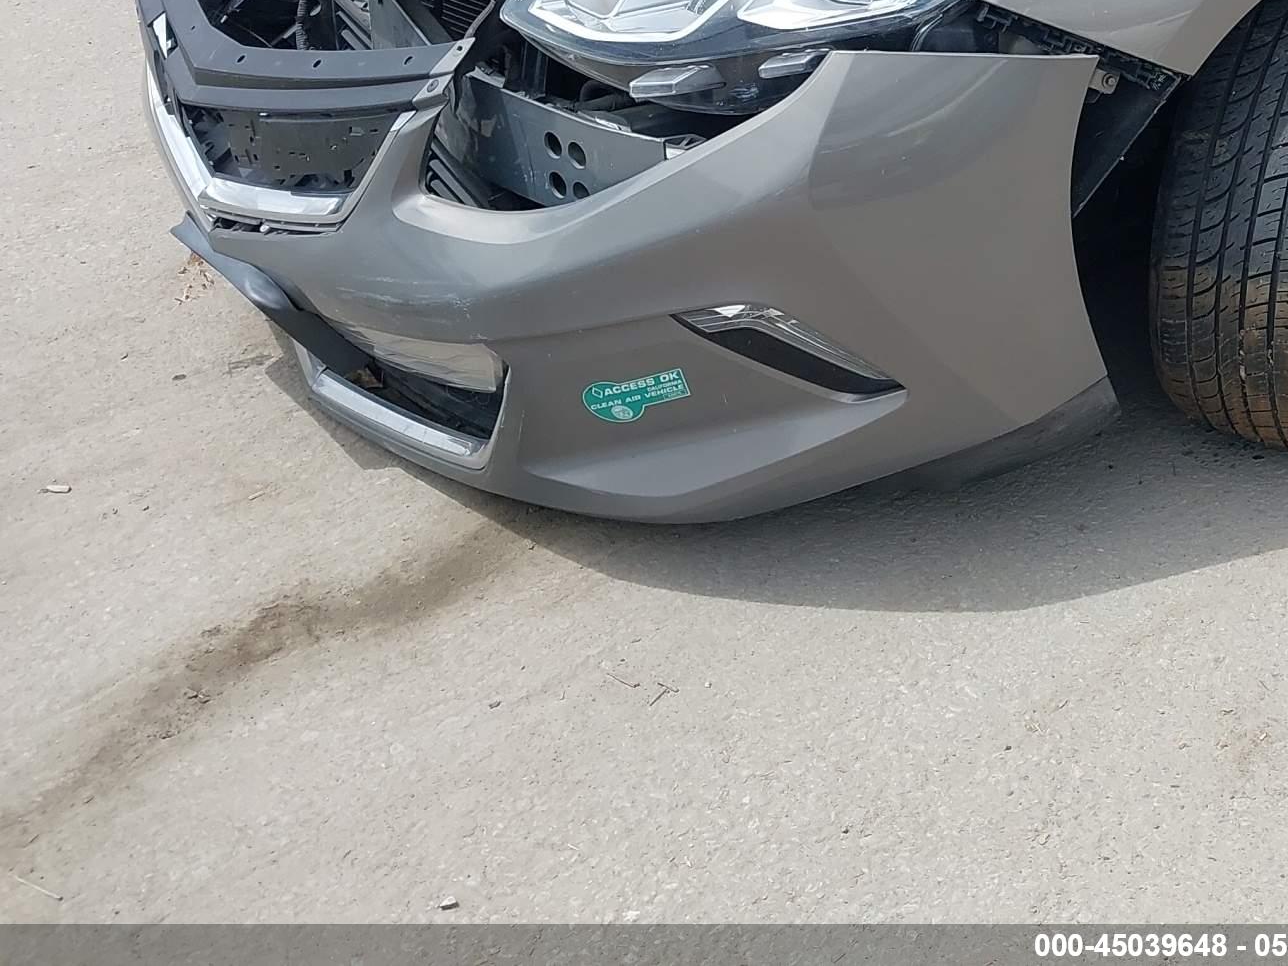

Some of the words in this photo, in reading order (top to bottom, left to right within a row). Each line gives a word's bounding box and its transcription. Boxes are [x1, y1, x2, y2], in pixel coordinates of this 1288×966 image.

[604, 378, 655, 396] ACCESS
[660, 371, 680, 383] OK
[591, 399, 622, 410] CLEAN
[625, 395, 641, 404] AIR
[644, 384, 683, 398] VEHICLE
